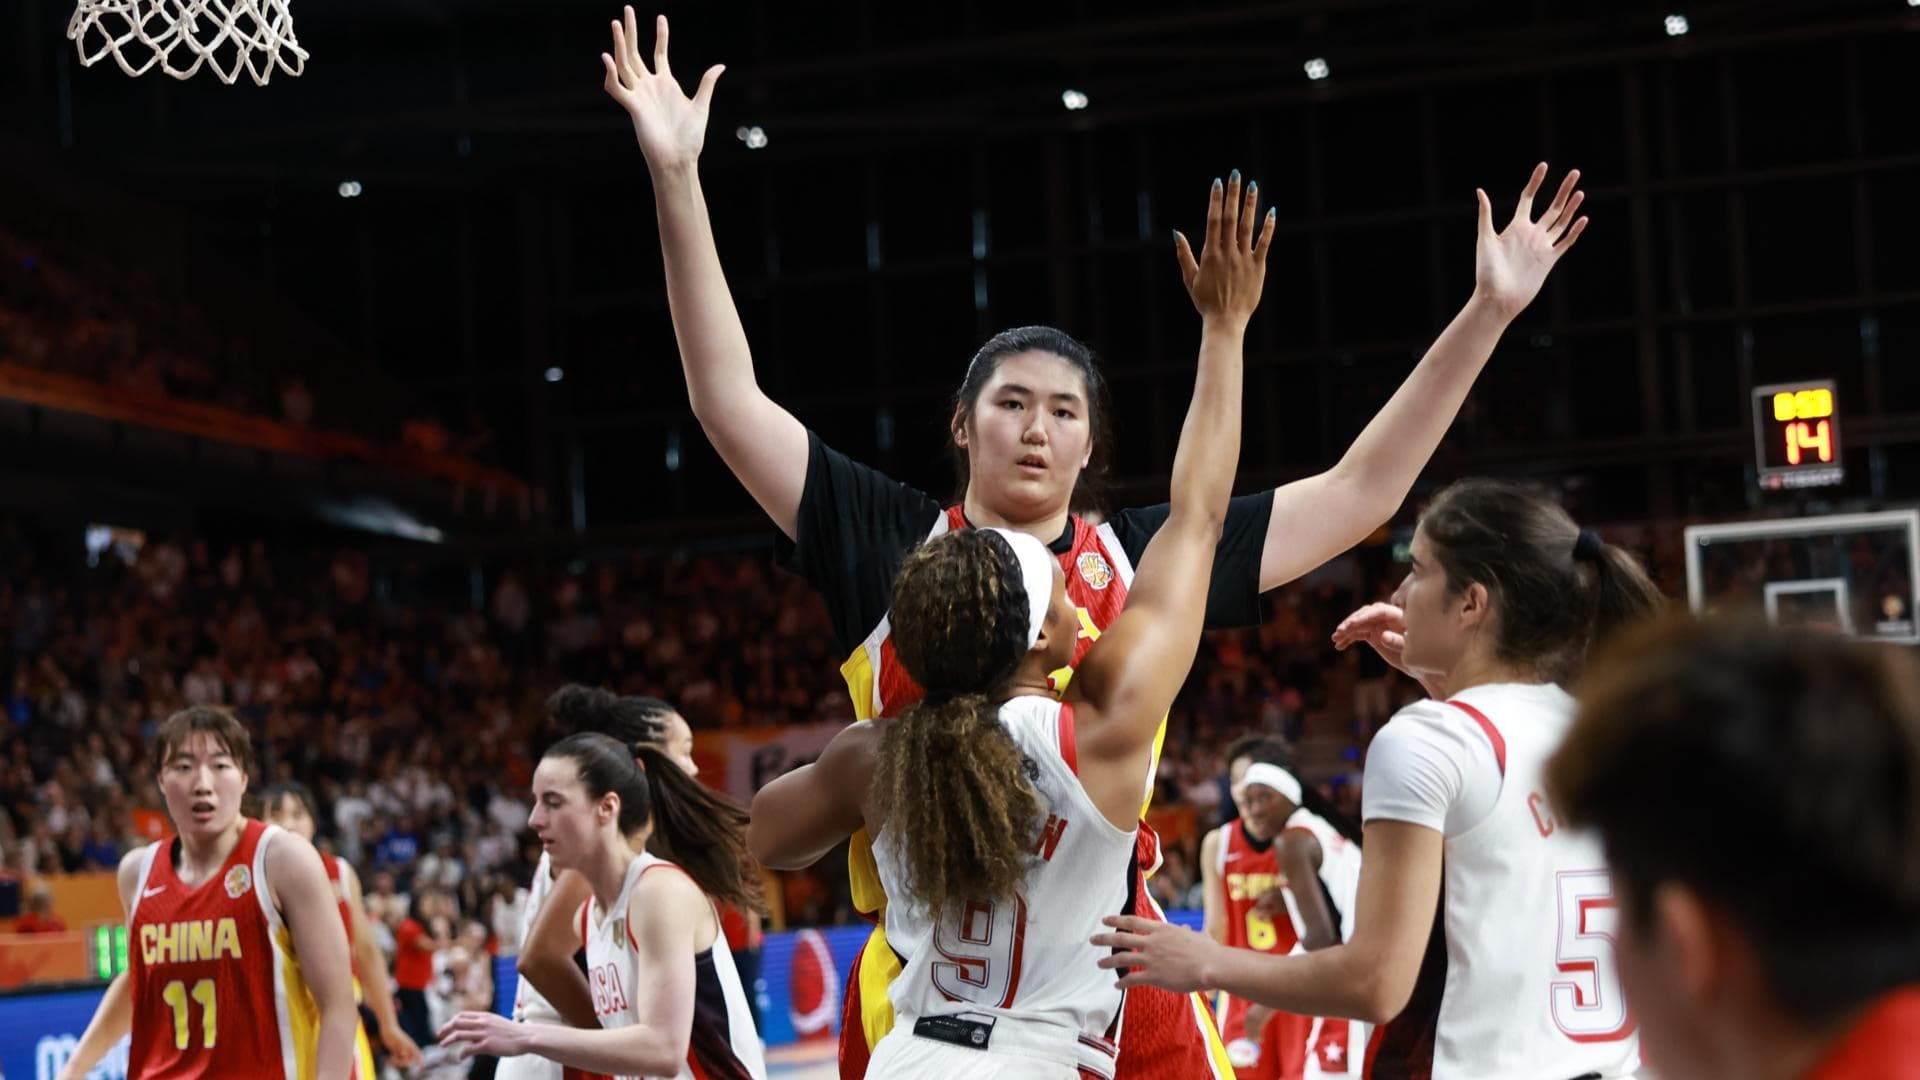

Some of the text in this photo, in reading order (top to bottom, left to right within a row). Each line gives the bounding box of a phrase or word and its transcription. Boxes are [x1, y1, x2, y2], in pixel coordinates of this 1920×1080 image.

[1786, 420, 1831, 465] 14
[140, 917, 242, 965] CHINA
[931, 893, 1028, 1009] 9
[1246, 907, 1278, 950] 6
[1550, 867, 1637, 1043] 5
[163, 978, 217, 1050] 11
